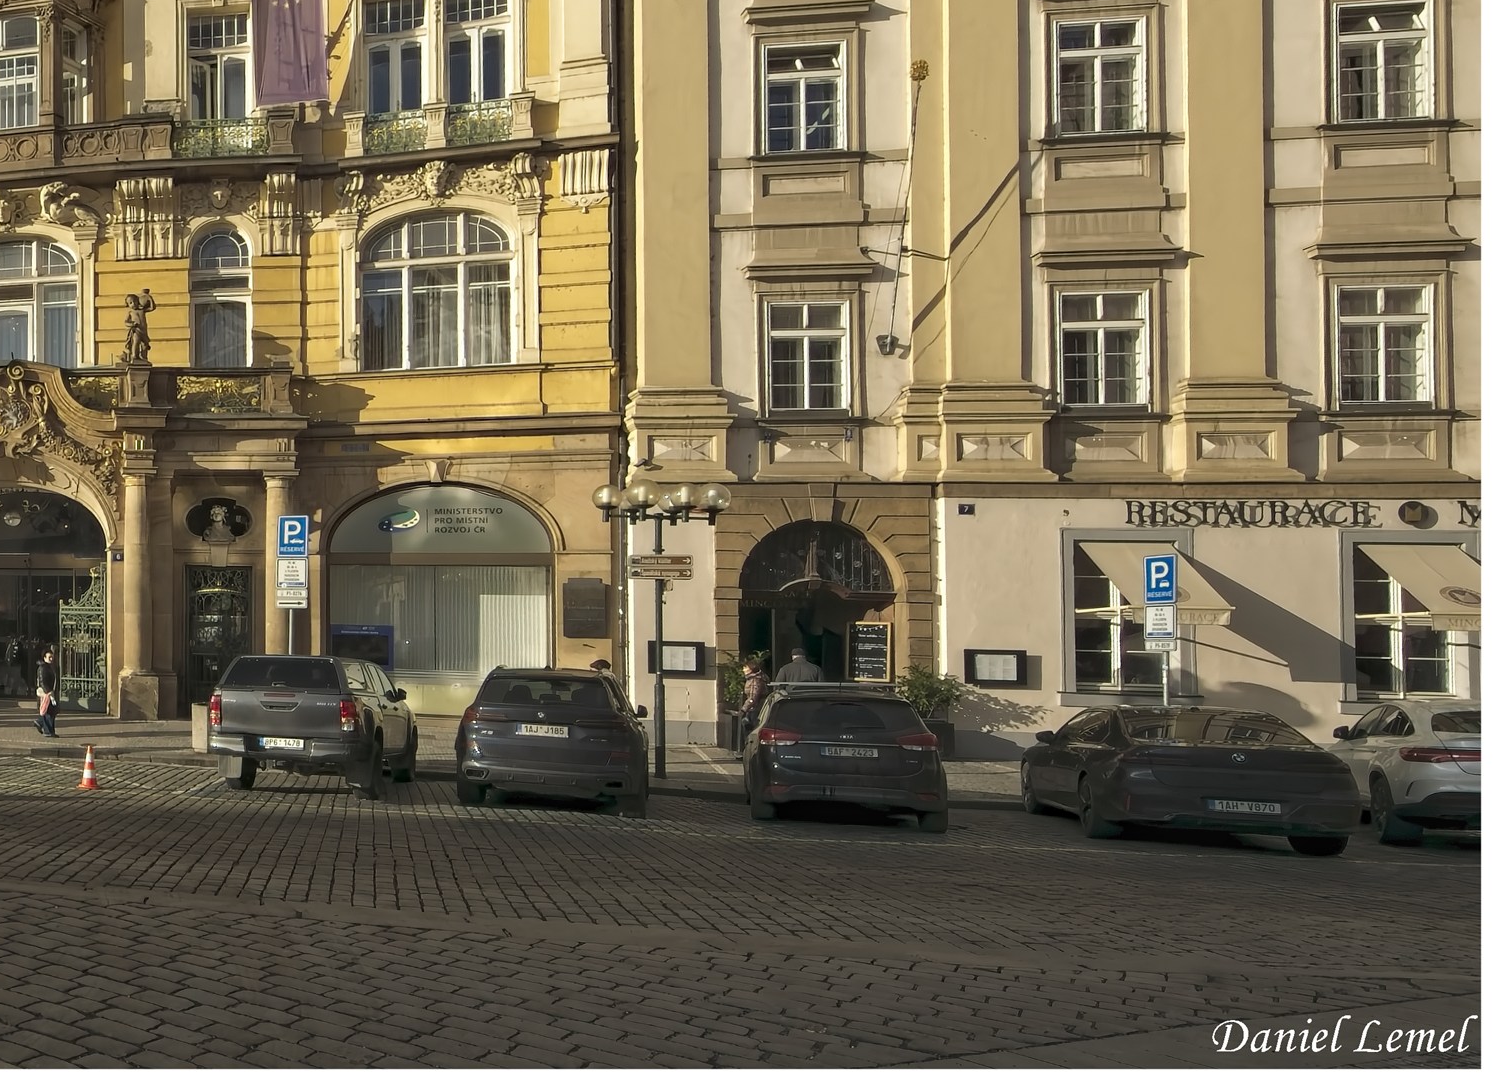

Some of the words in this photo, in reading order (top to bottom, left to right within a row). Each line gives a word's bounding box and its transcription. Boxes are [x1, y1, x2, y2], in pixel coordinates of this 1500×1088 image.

[434, 507, 503, 515] MINISTERSTVO
[1125, 499, 1372, 524] RESTAURACE
[456, 516, 489, 524] MÍSTNÍ
[284, 521, 301, 544] P
[434, 526, 471, 534] ROZVOJ
[474, 525, 486, 533] ČR
[1151, 561, 1169, 589] P
[524, 725, 538, 733] 1AJ
[544, 726, 565, 735] J185
[1218, 801, 1239, 810] 1AH
[1247, 803, 1275, 812] V870
